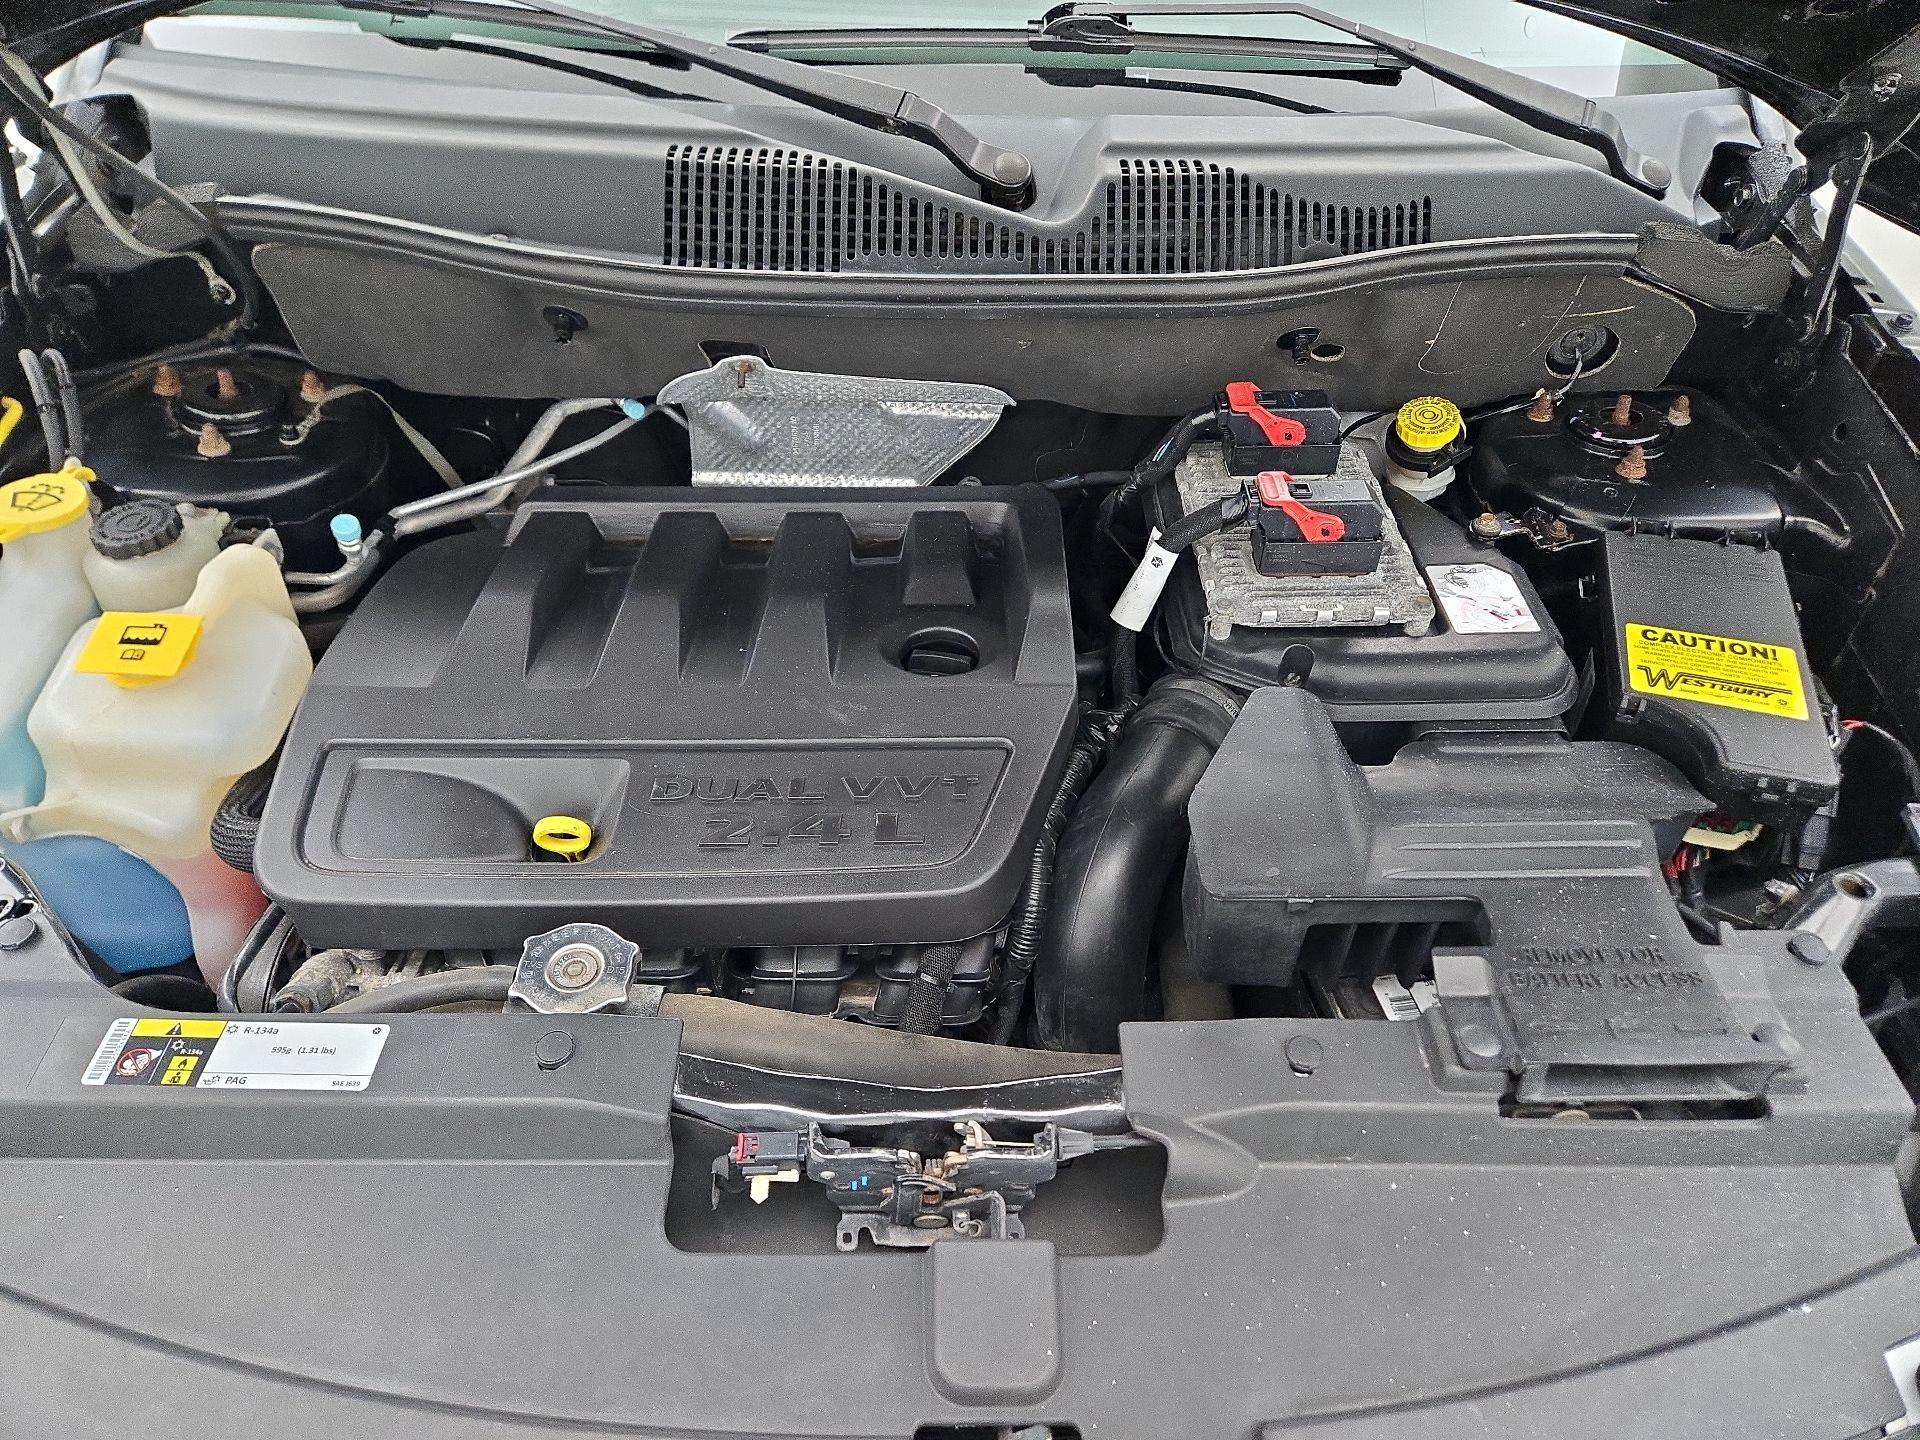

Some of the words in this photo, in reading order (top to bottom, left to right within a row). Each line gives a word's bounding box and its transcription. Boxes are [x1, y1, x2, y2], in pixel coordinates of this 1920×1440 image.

[1638, 639, 1674, 649] COMPLEX
[1676, 646, 1725, 658] ELECTRONIC
[1727, 654, 1782, 667] COMPONENTS
[1641, 629, 1778, 661] CAUTION!
[1638, 665, 1780, 698] WESTBURY
[650, 776, 826, 801] DUAL
[841, 774, 979, 800] VVT
[1518, 946, 1605, 965] REMOVE
[1615, 946, 1667, 965] FOR
[1507, 970, 1602, 989] BATTERY
[1612, 970, 1704, 989] ACCESS
[244, 1026, 279, 1035] R-134a
[270, 1046, 292, 1055] 595g
[297, 1046, 319, 1055] (1.31
[320, 1046, 337, 1056] lbs)
[224, 1076, 248, 1085] PAG
